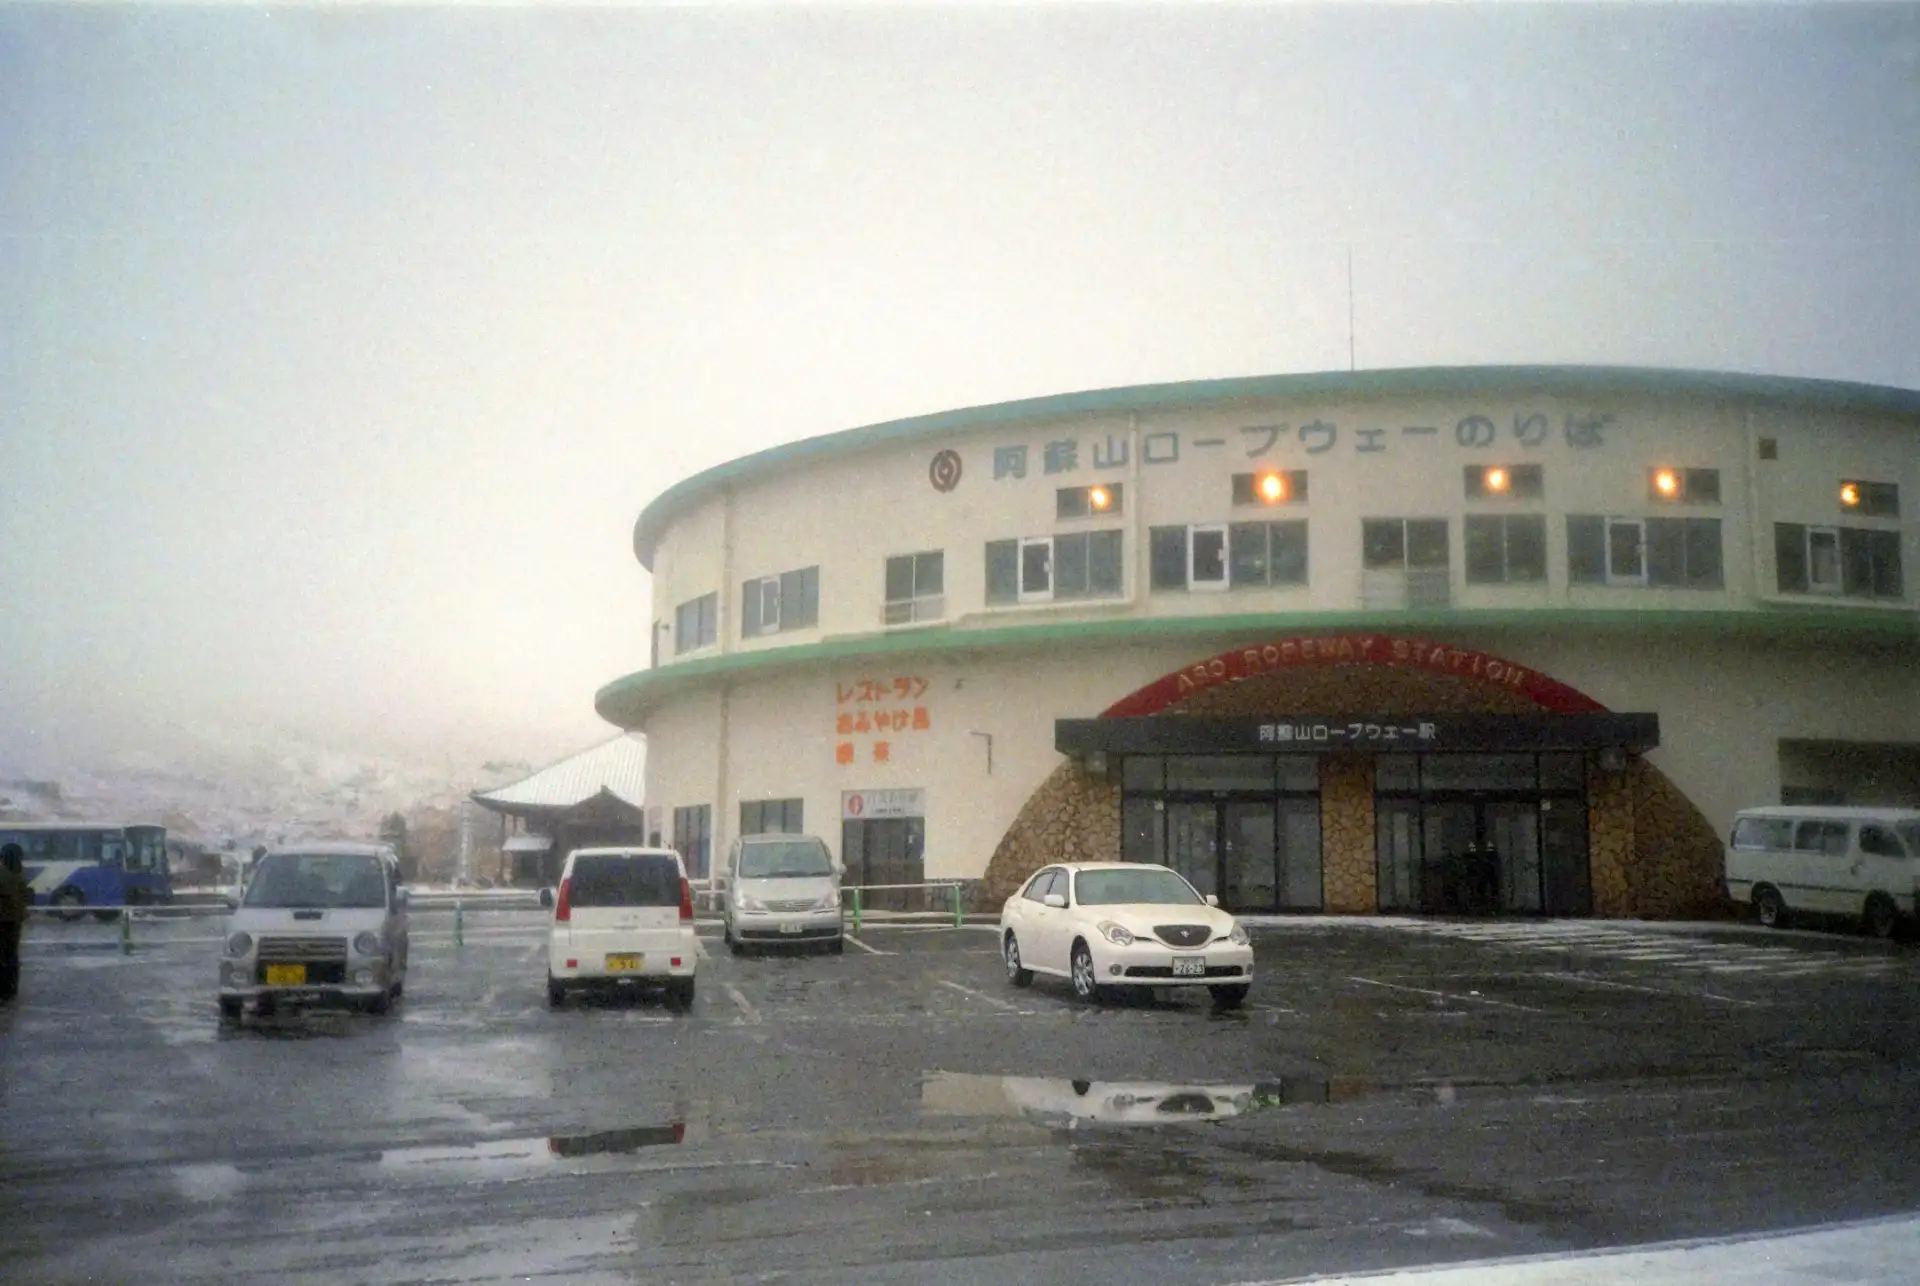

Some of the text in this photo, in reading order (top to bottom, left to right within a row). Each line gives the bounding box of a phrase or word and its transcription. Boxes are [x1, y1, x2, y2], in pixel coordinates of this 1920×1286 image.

[1243, 635, 1375, 674] ROPEWAY
[1390, 638, 1526, 686] STATION
[836, 676, 930, 704] レストラン
